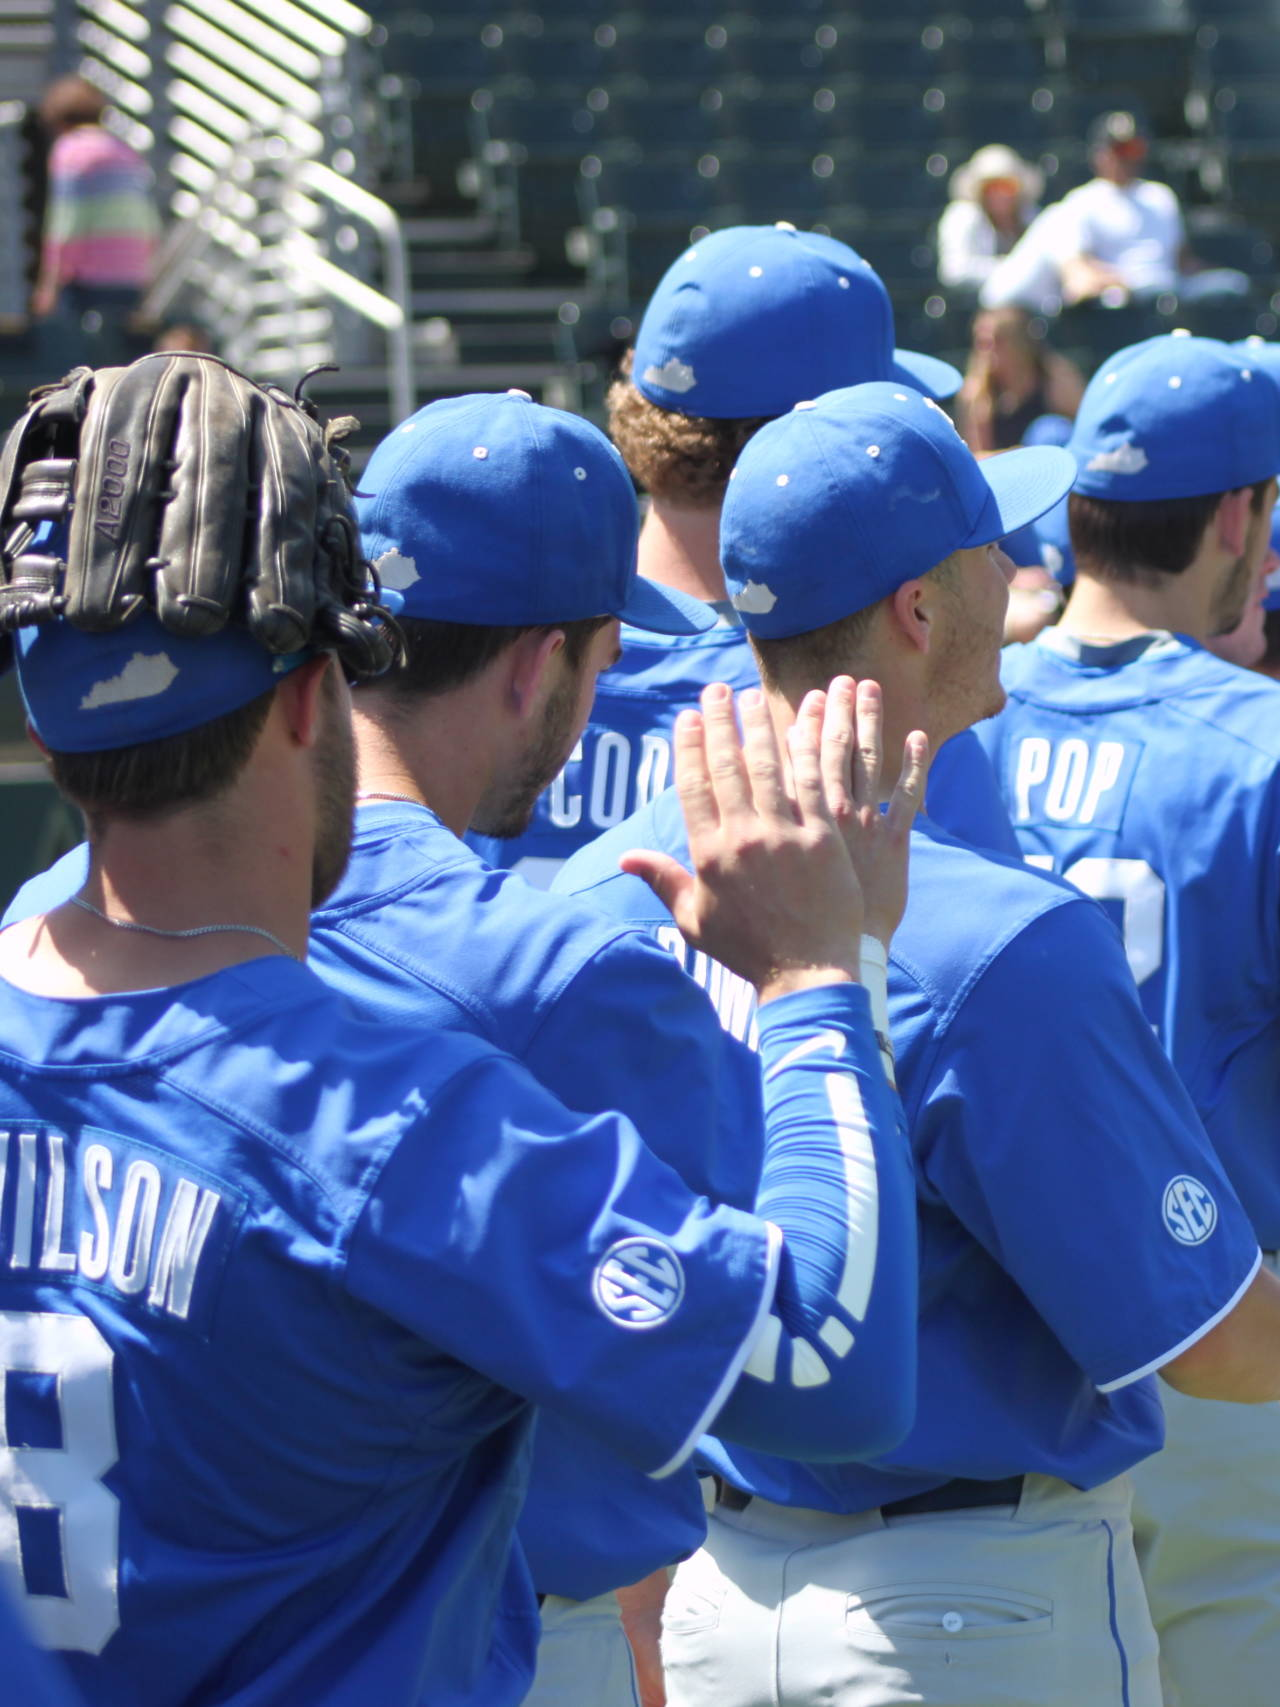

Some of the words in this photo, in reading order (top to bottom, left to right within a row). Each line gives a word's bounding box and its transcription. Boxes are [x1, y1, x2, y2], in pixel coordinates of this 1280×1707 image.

[95, 438, 131, 543] A2000
[1015, 737, 1125, 825] POP
[0, 1132, 220, 1320] ILSON
[1166, 1179, 1214, 1242] SEC
[598, 1244, 680, 1322] SEC
